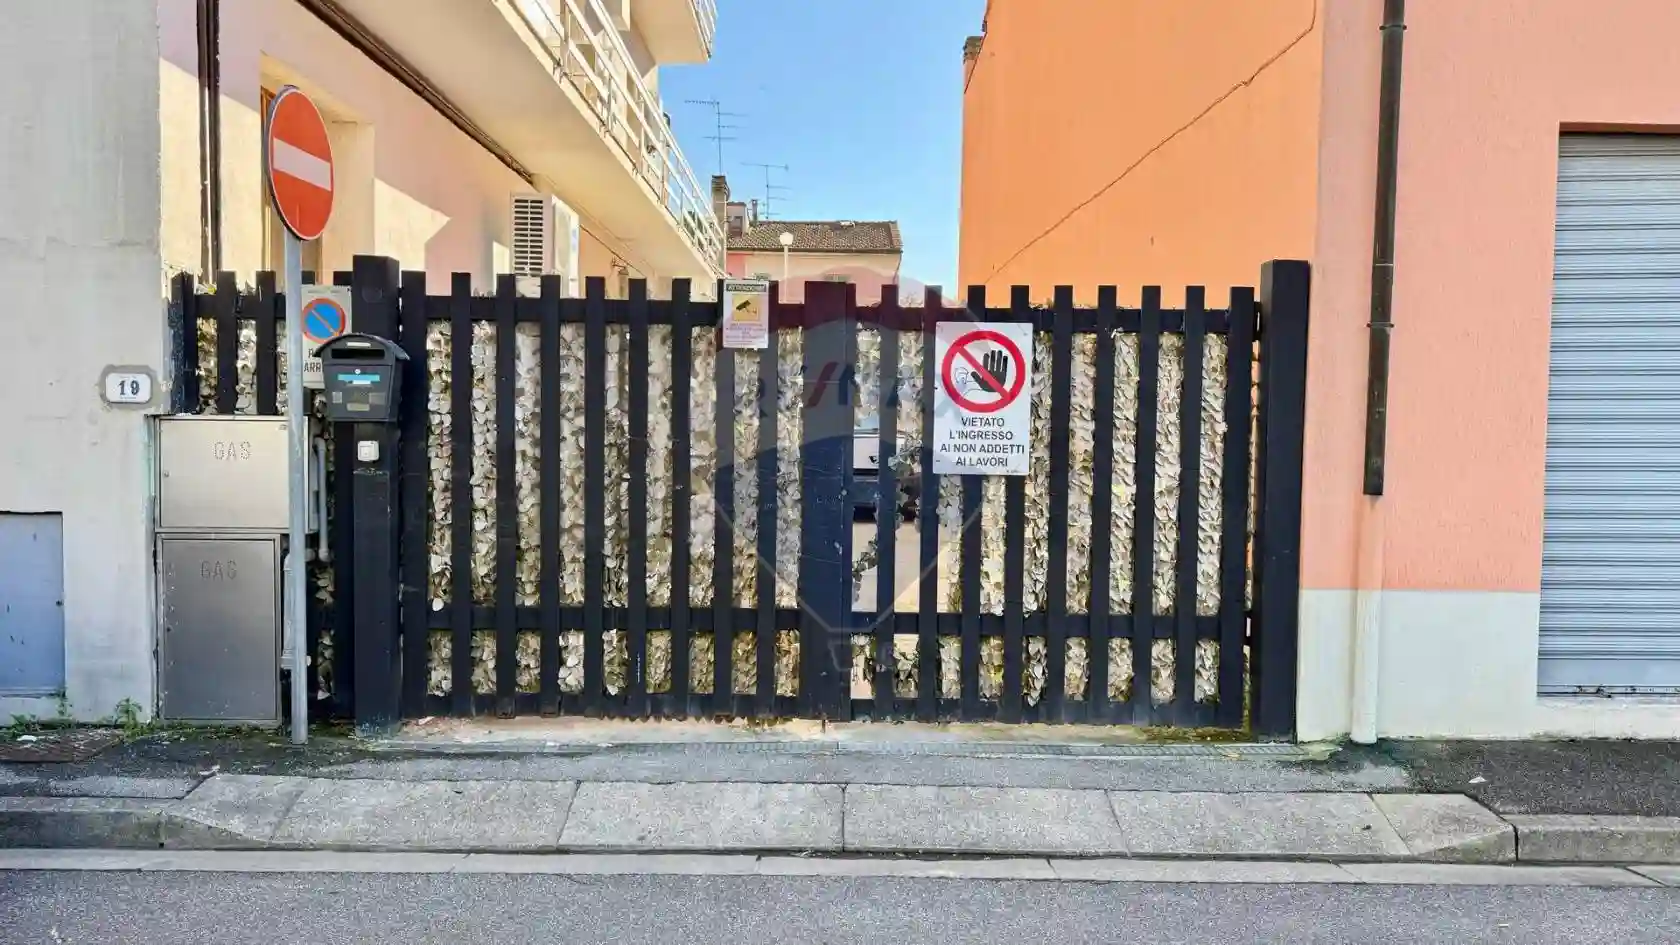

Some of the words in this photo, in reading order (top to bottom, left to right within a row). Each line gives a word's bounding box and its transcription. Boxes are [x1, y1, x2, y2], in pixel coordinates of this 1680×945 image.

[117, 380, 141, 396] 19
[961, 417, 1005, 428] VIETATO
[949, 430, 1014, 441] L'INGRESSO
[214, 441, 252, 461] GAS
[940, 443, 951, 453] AI
[953, 443, 977, 453] NON
[979, 444, 1025, 455] ADDETTI
[955, 457, 966, 467] AI
[969, 457, 1009, 467] LAVORI
[201, 560, 238, 581] GAS
